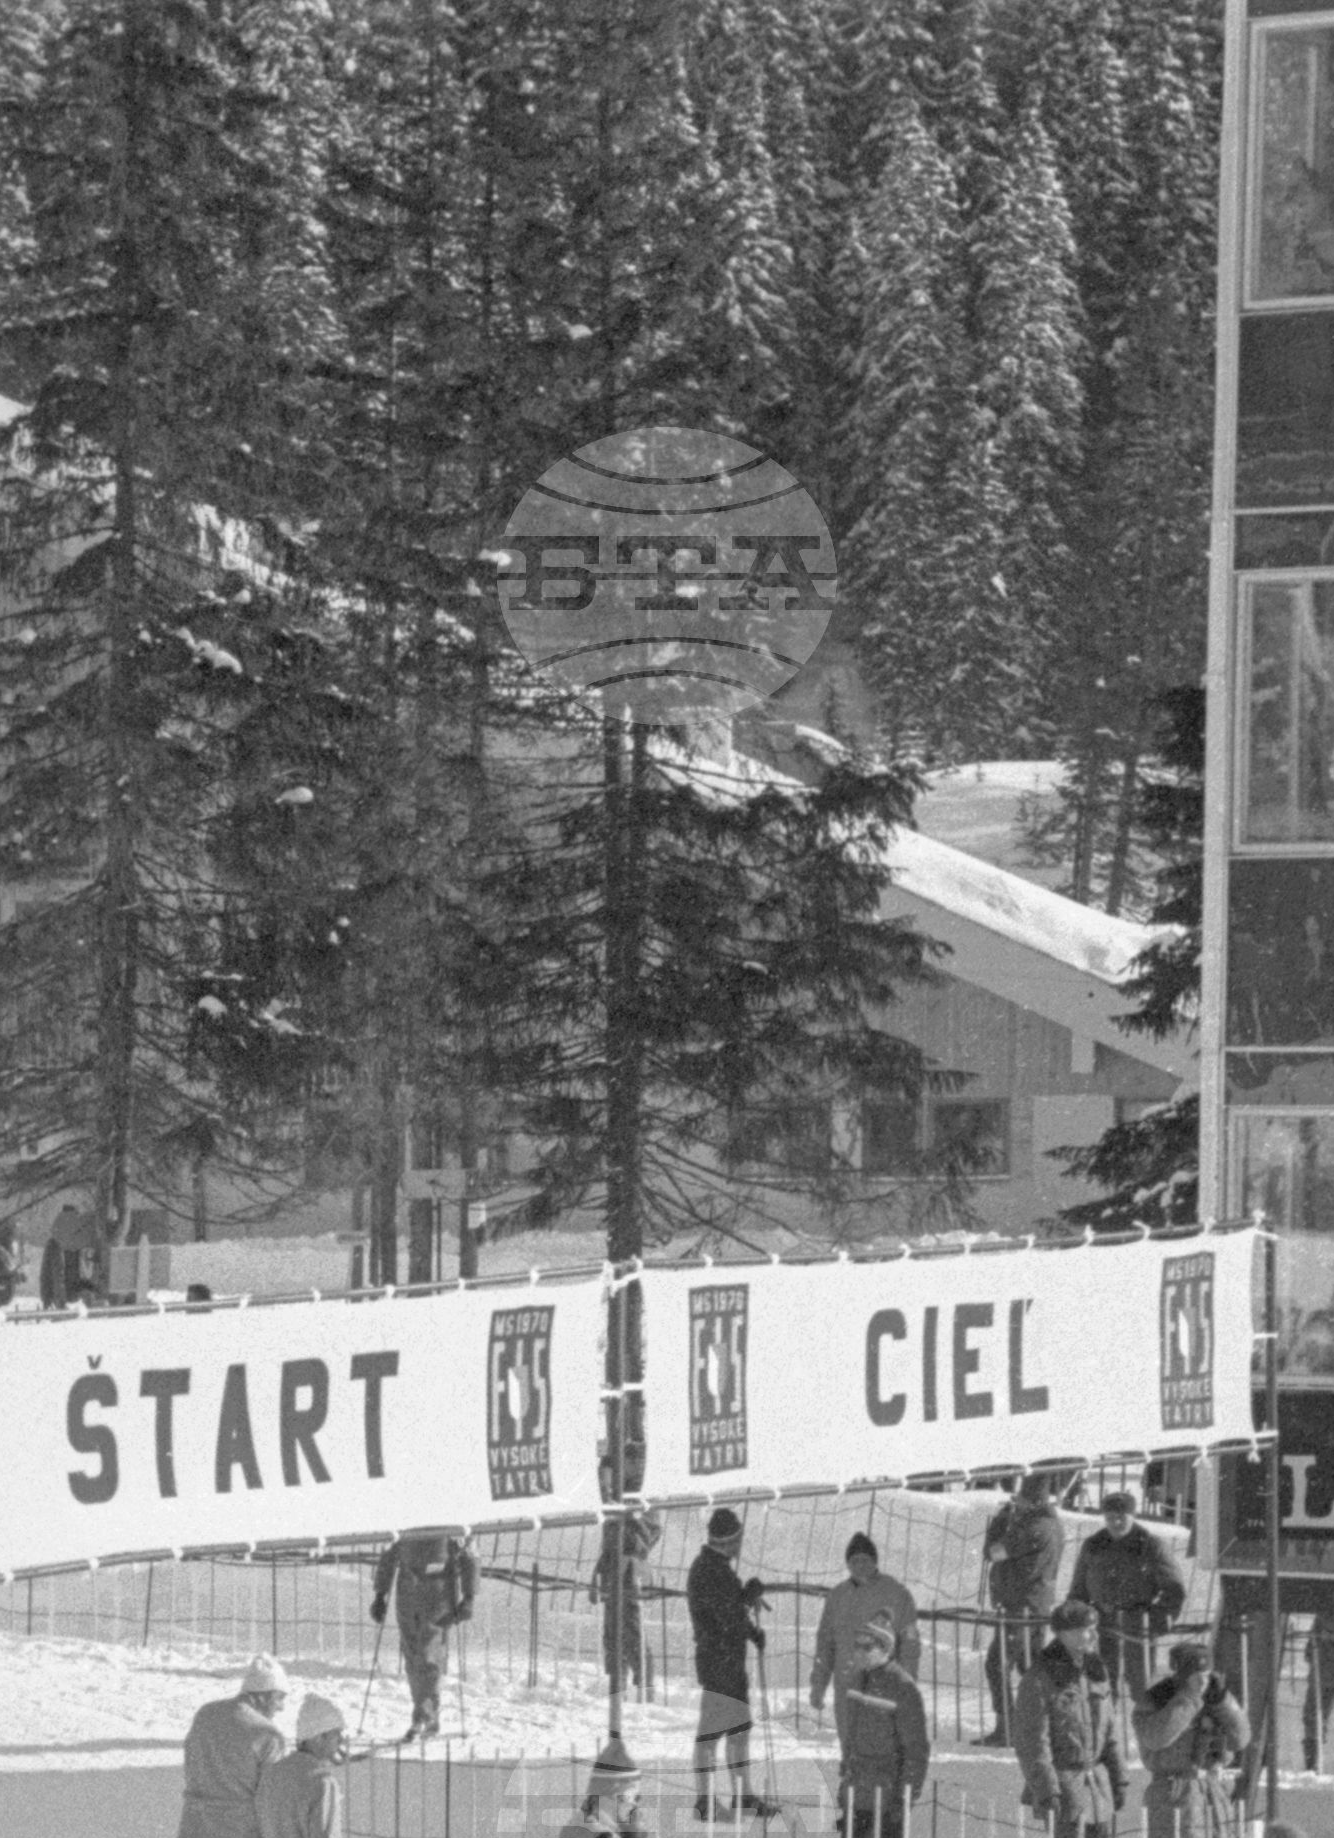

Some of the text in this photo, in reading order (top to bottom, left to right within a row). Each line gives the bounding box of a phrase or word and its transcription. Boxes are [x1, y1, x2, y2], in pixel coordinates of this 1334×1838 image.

[66, 1351, 400, 1505] ŠTART
[692, 1443, 746, 1470] TATRY
[491, 1469, 550, 1495] TATRY
